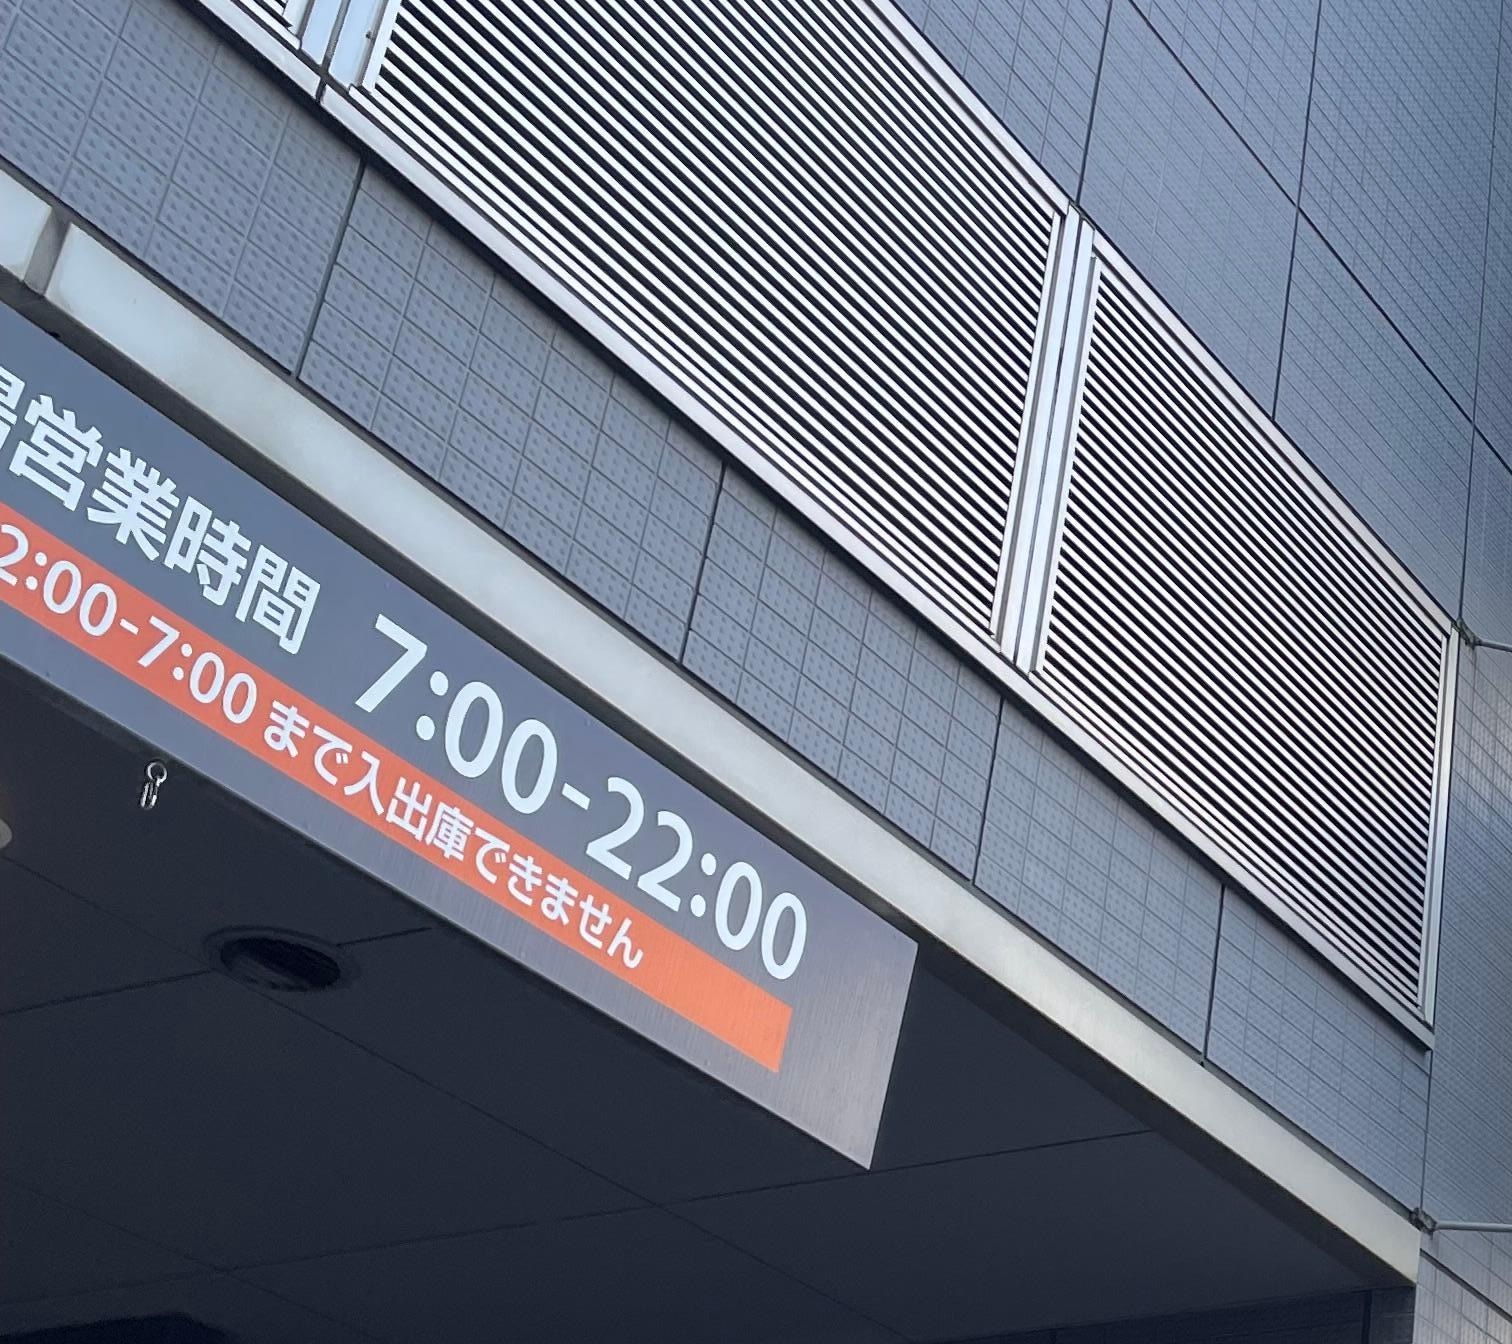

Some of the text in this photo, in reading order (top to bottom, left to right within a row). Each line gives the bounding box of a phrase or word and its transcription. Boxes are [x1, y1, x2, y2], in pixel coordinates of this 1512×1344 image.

[262, 702, 645, 970] まで入出庫できません
[353, 612, 808, 982] 7:00-22:00
